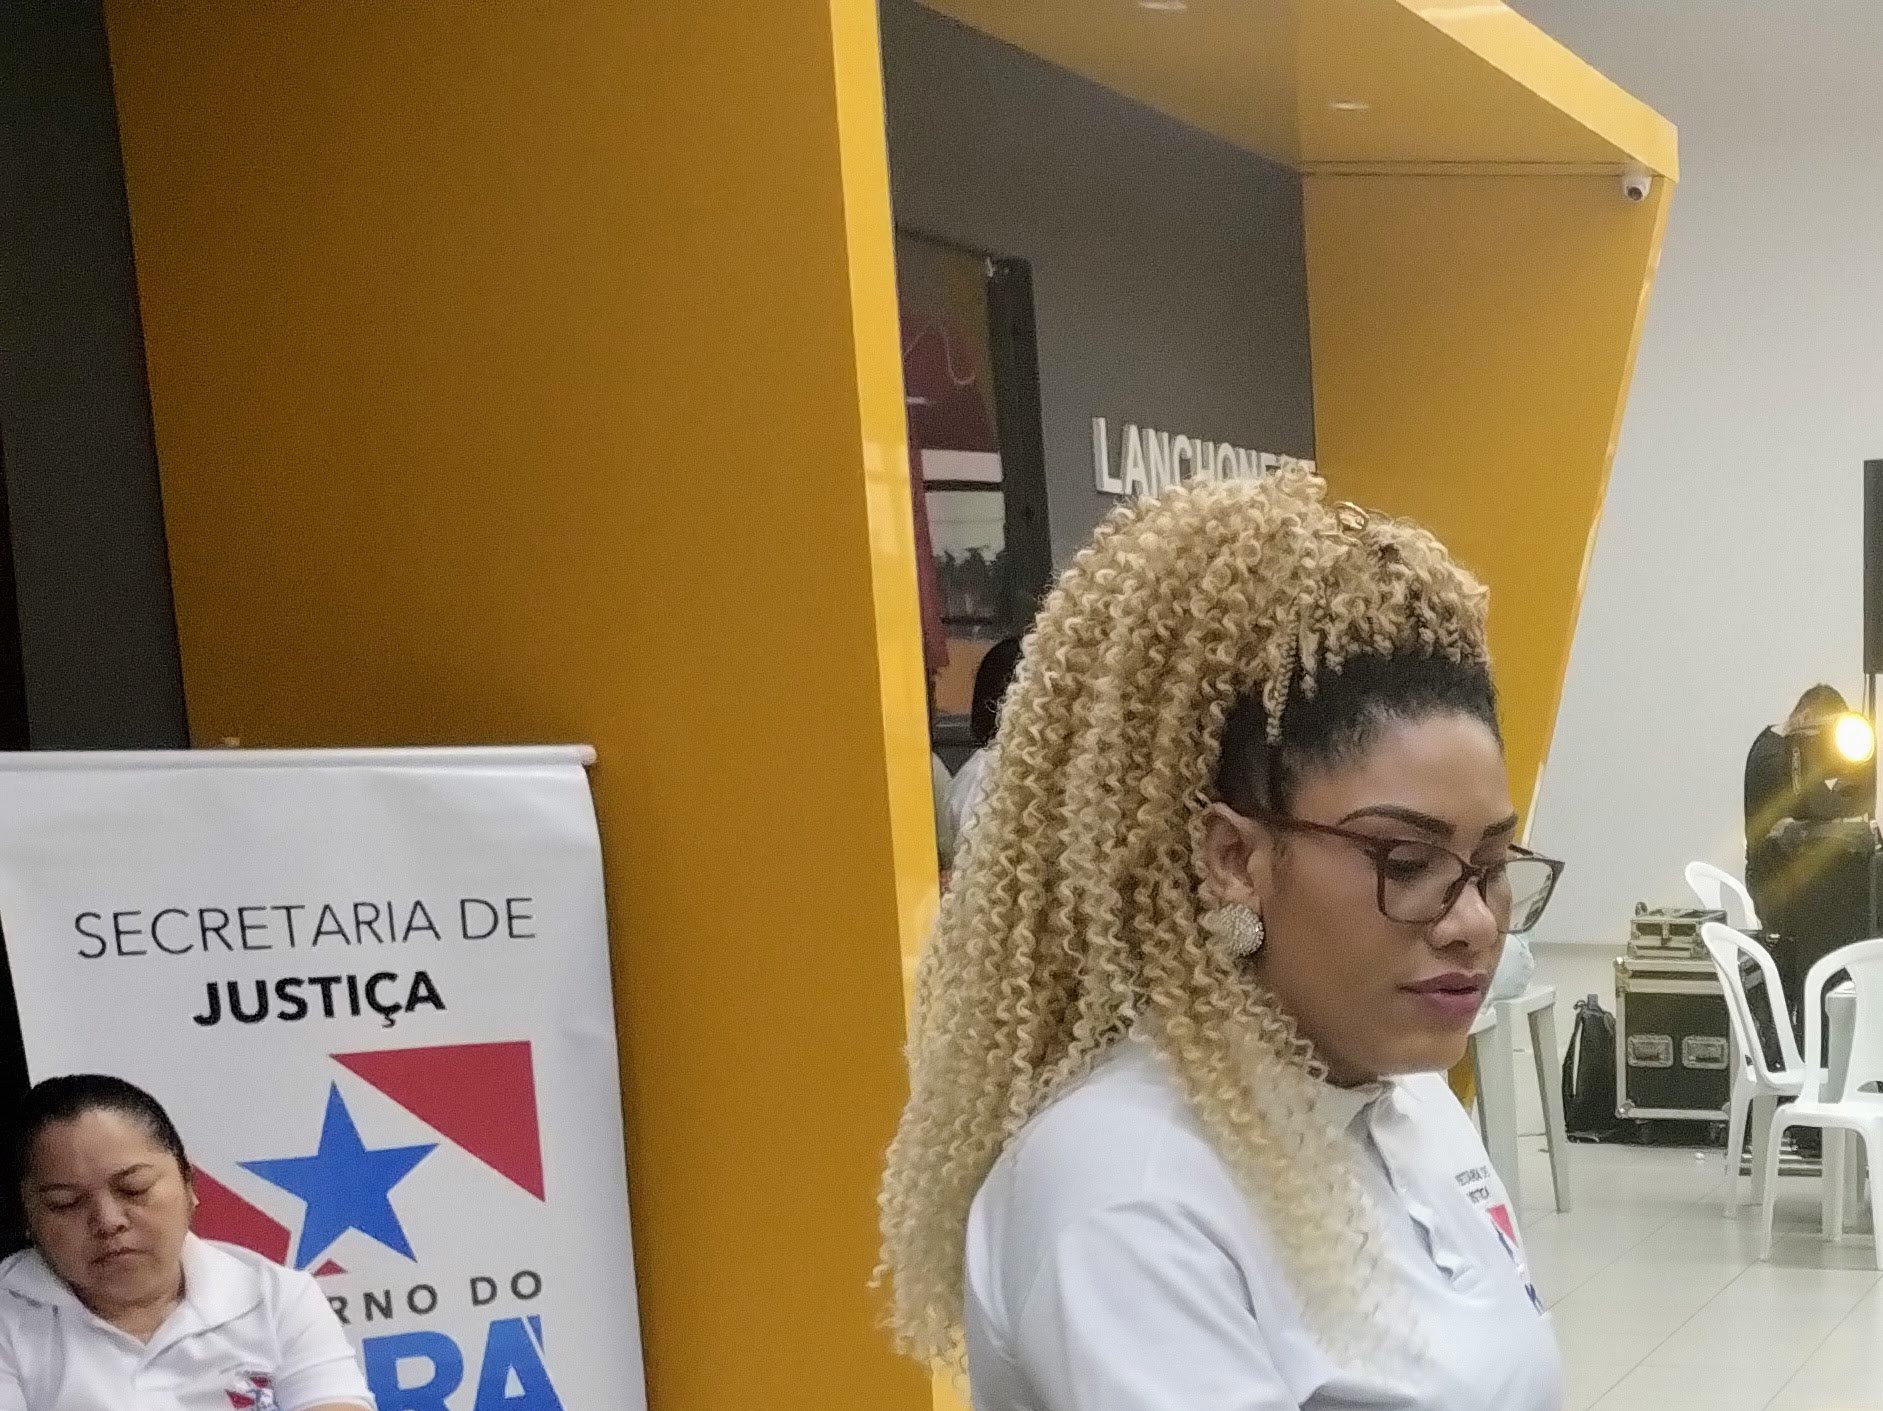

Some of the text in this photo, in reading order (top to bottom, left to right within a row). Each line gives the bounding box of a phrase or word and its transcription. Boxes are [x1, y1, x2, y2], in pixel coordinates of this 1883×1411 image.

[74, 897, 537, 960] SECRETARIA DE
[192, 970, 447, 1029] JUSTIÇA
[469, 1269, 543, 1307] DO
